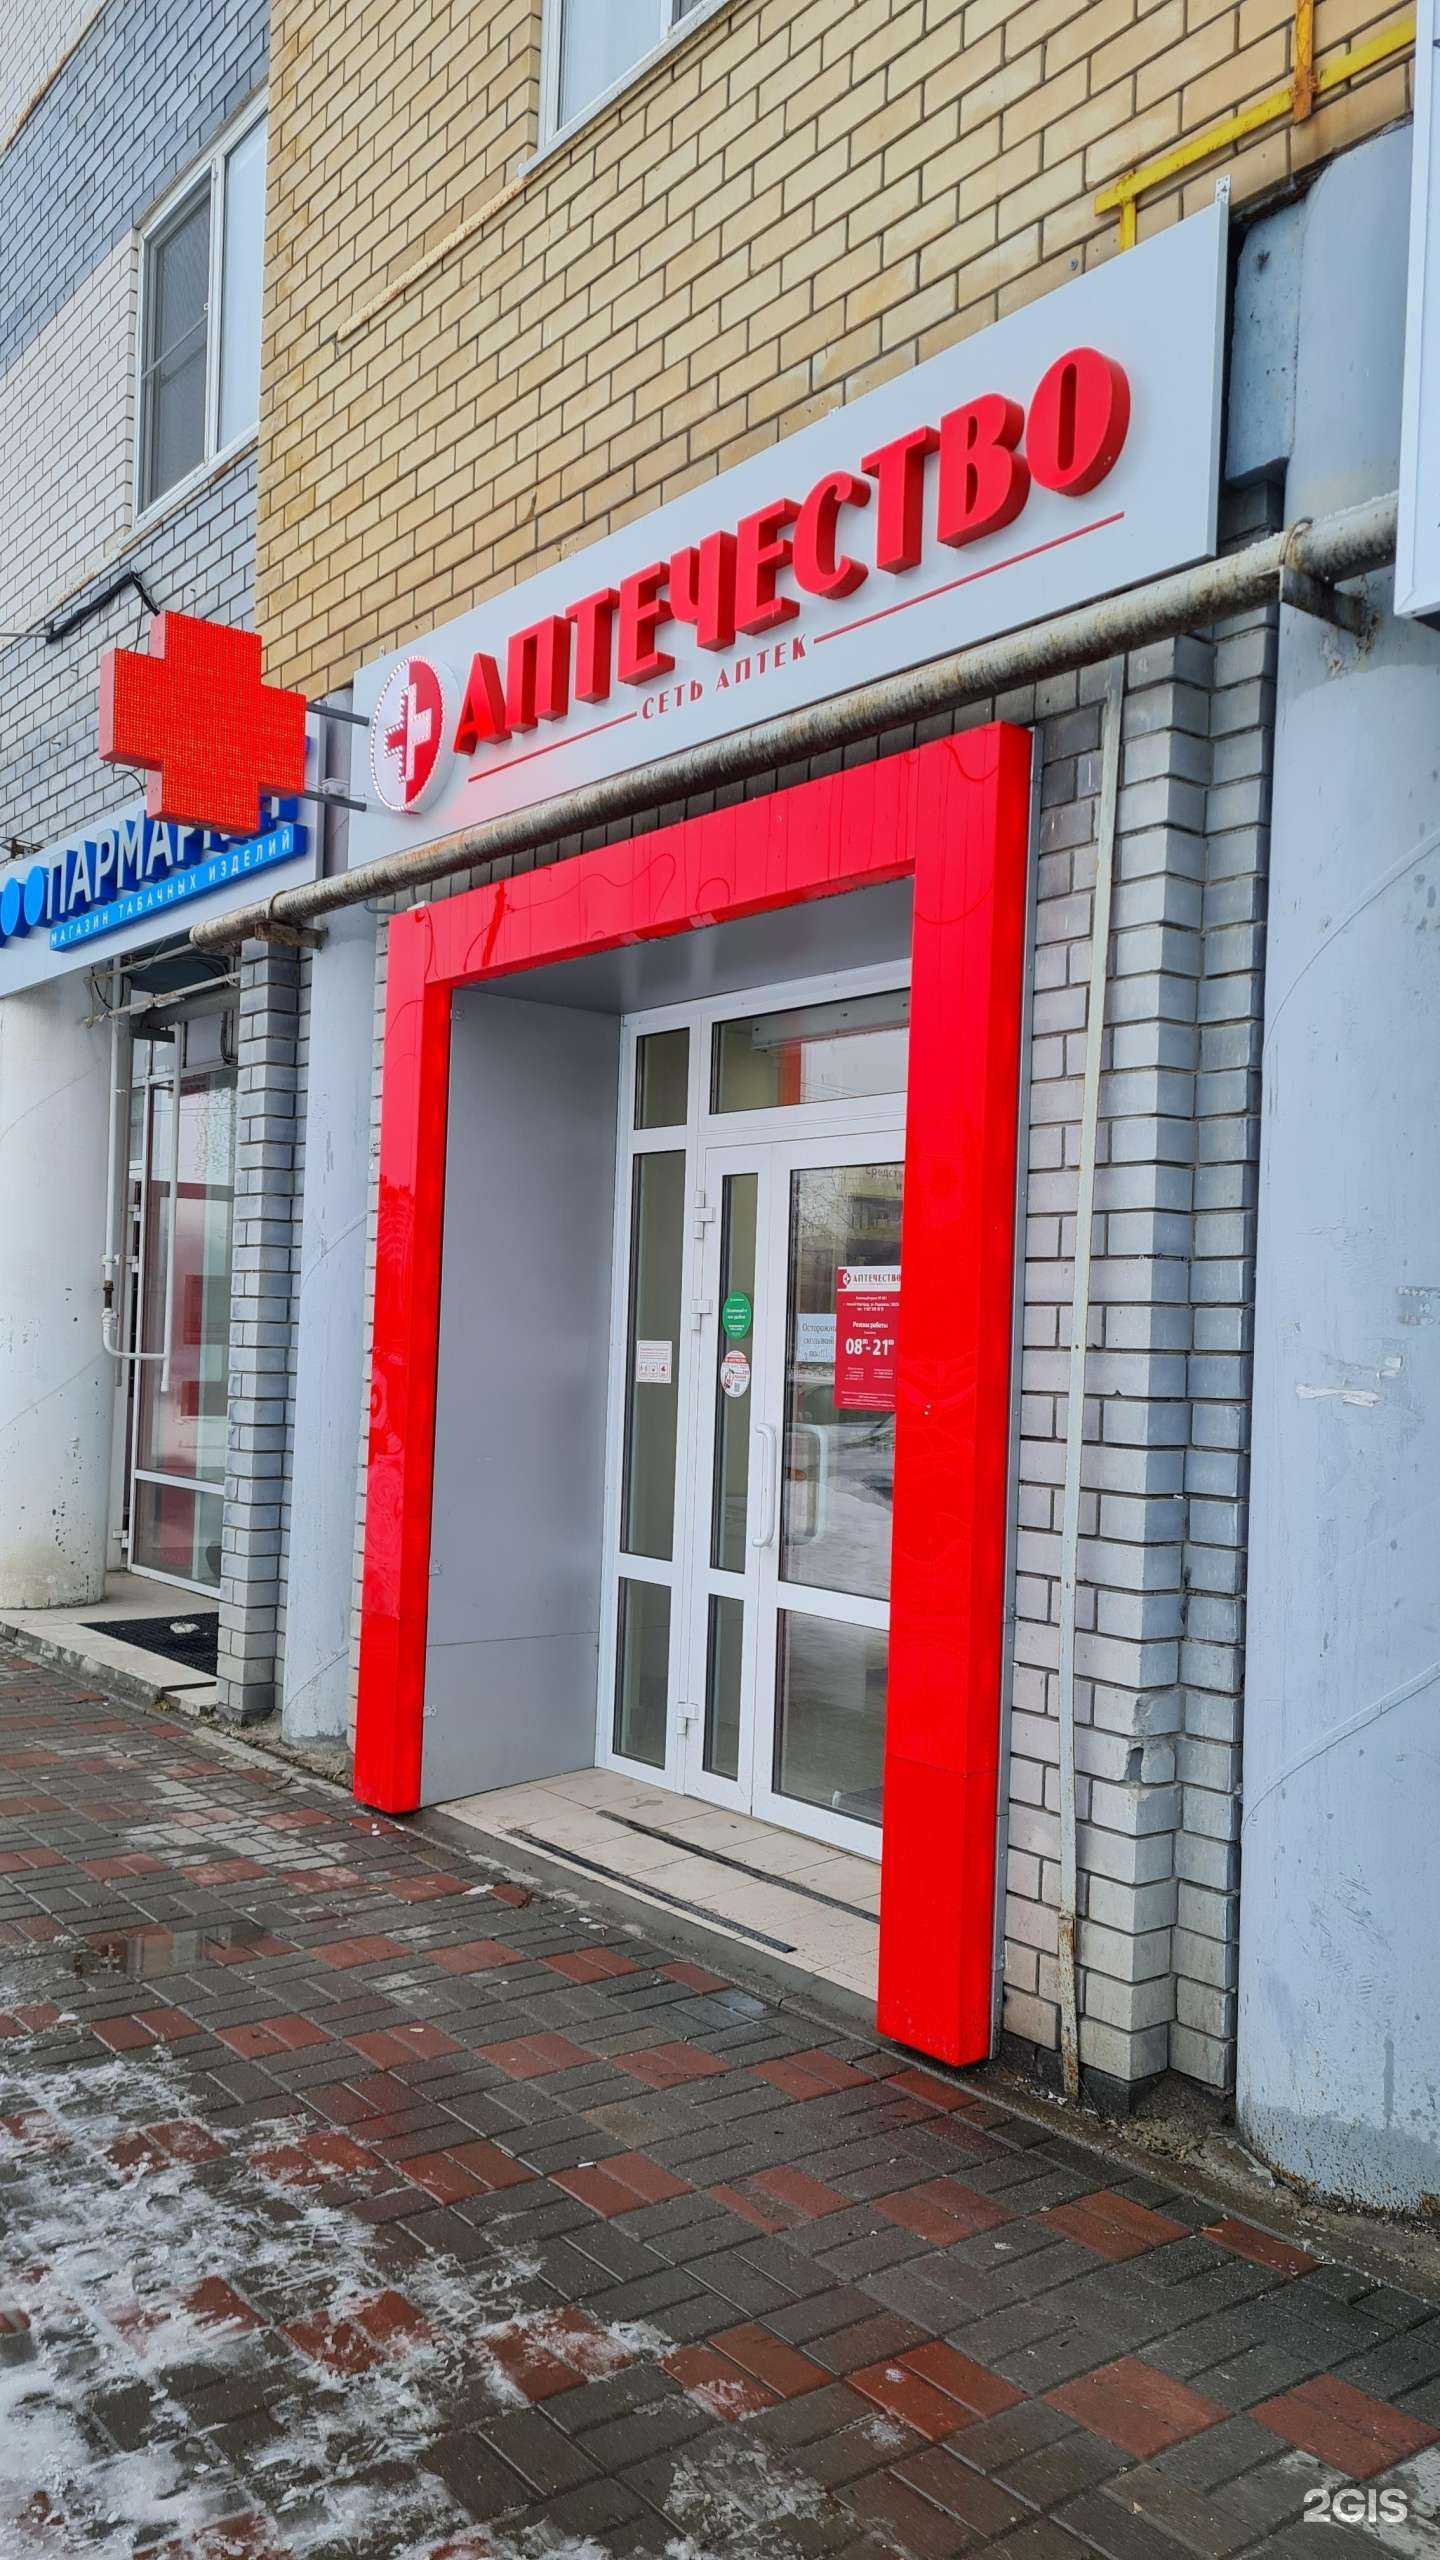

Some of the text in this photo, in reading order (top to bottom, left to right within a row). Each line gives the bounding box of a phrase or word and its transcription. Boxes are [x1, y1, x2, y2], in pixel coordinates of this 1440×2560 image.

[453, 345, 1131, 755] АПТЕЧЕСТВО
[642, 633, 807, 720] СЕТЬ АПТЕК
[51, 831, 291, 946] МАГАЗИН ТАБАЧНЫХ ИЗДЕЛИЙ
